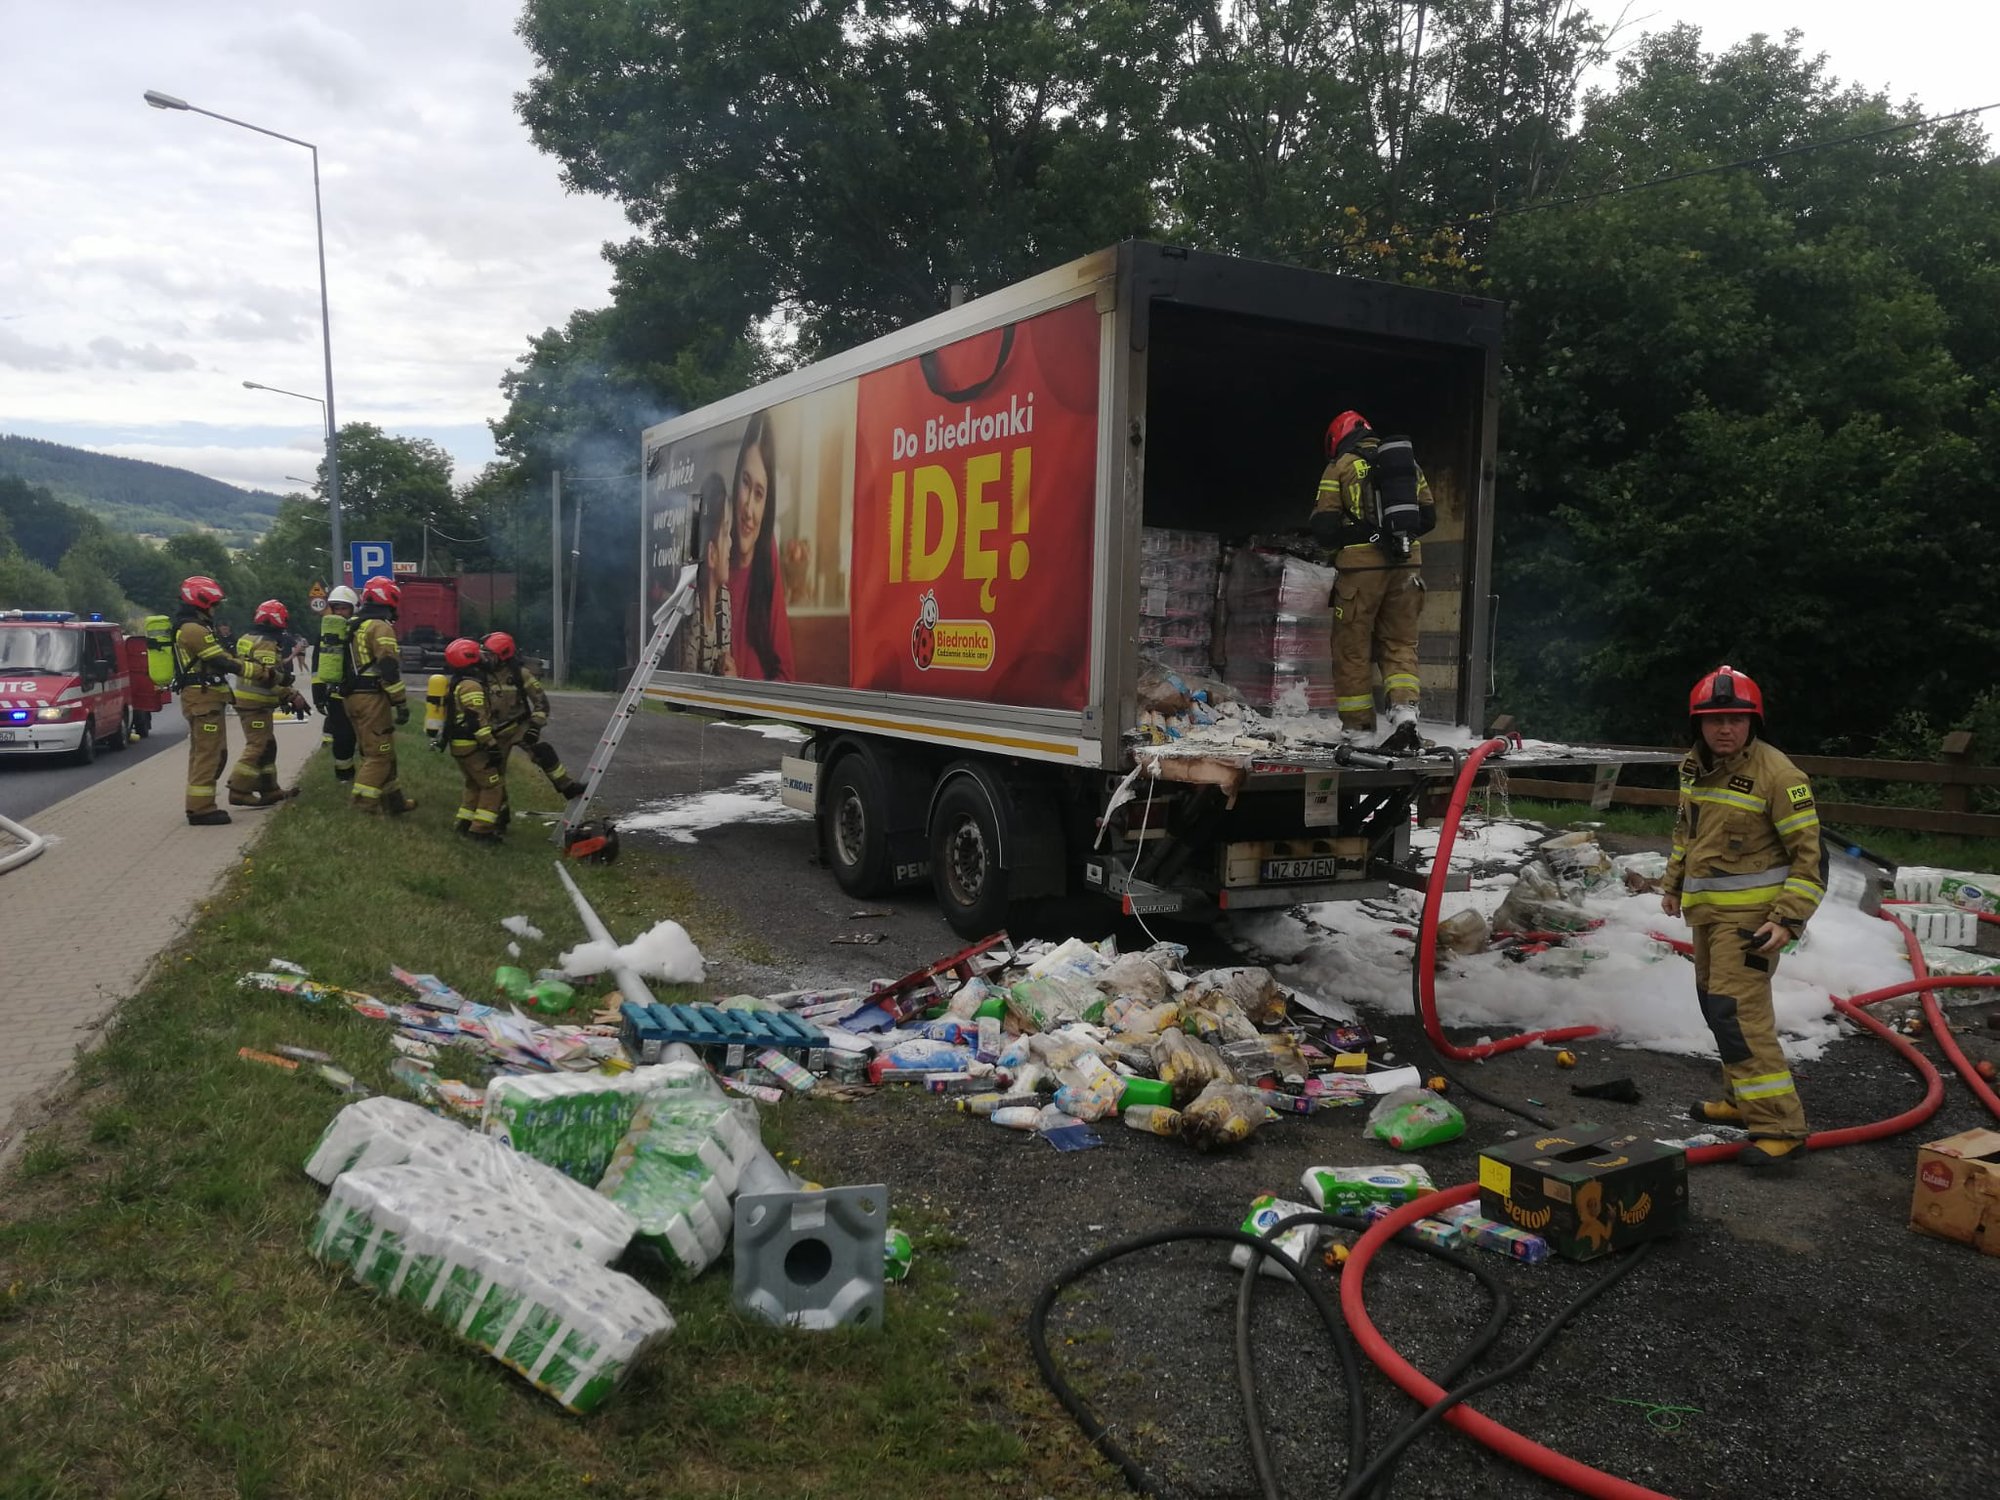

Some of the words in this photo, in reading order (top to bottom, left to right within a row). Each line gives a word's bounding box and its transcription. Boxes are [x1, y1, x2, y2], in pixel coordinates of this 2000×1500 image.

[893, 427, 919, 461] Do
[925, 391, 1034, 454] Biedronki
[888, 446, 1032, 614] IDĘ!
[360, 546, 385, 576] P
[312, 600, 325, 609] 40
[937, 630, 989, 649] Biedronka
[789, 777, 813, 794] KRONE
[1791, 786, 1807, 799] PSP
[1271, 861, 1289, 878] WZ
[1292, 858, 1333, 877] 871EN
